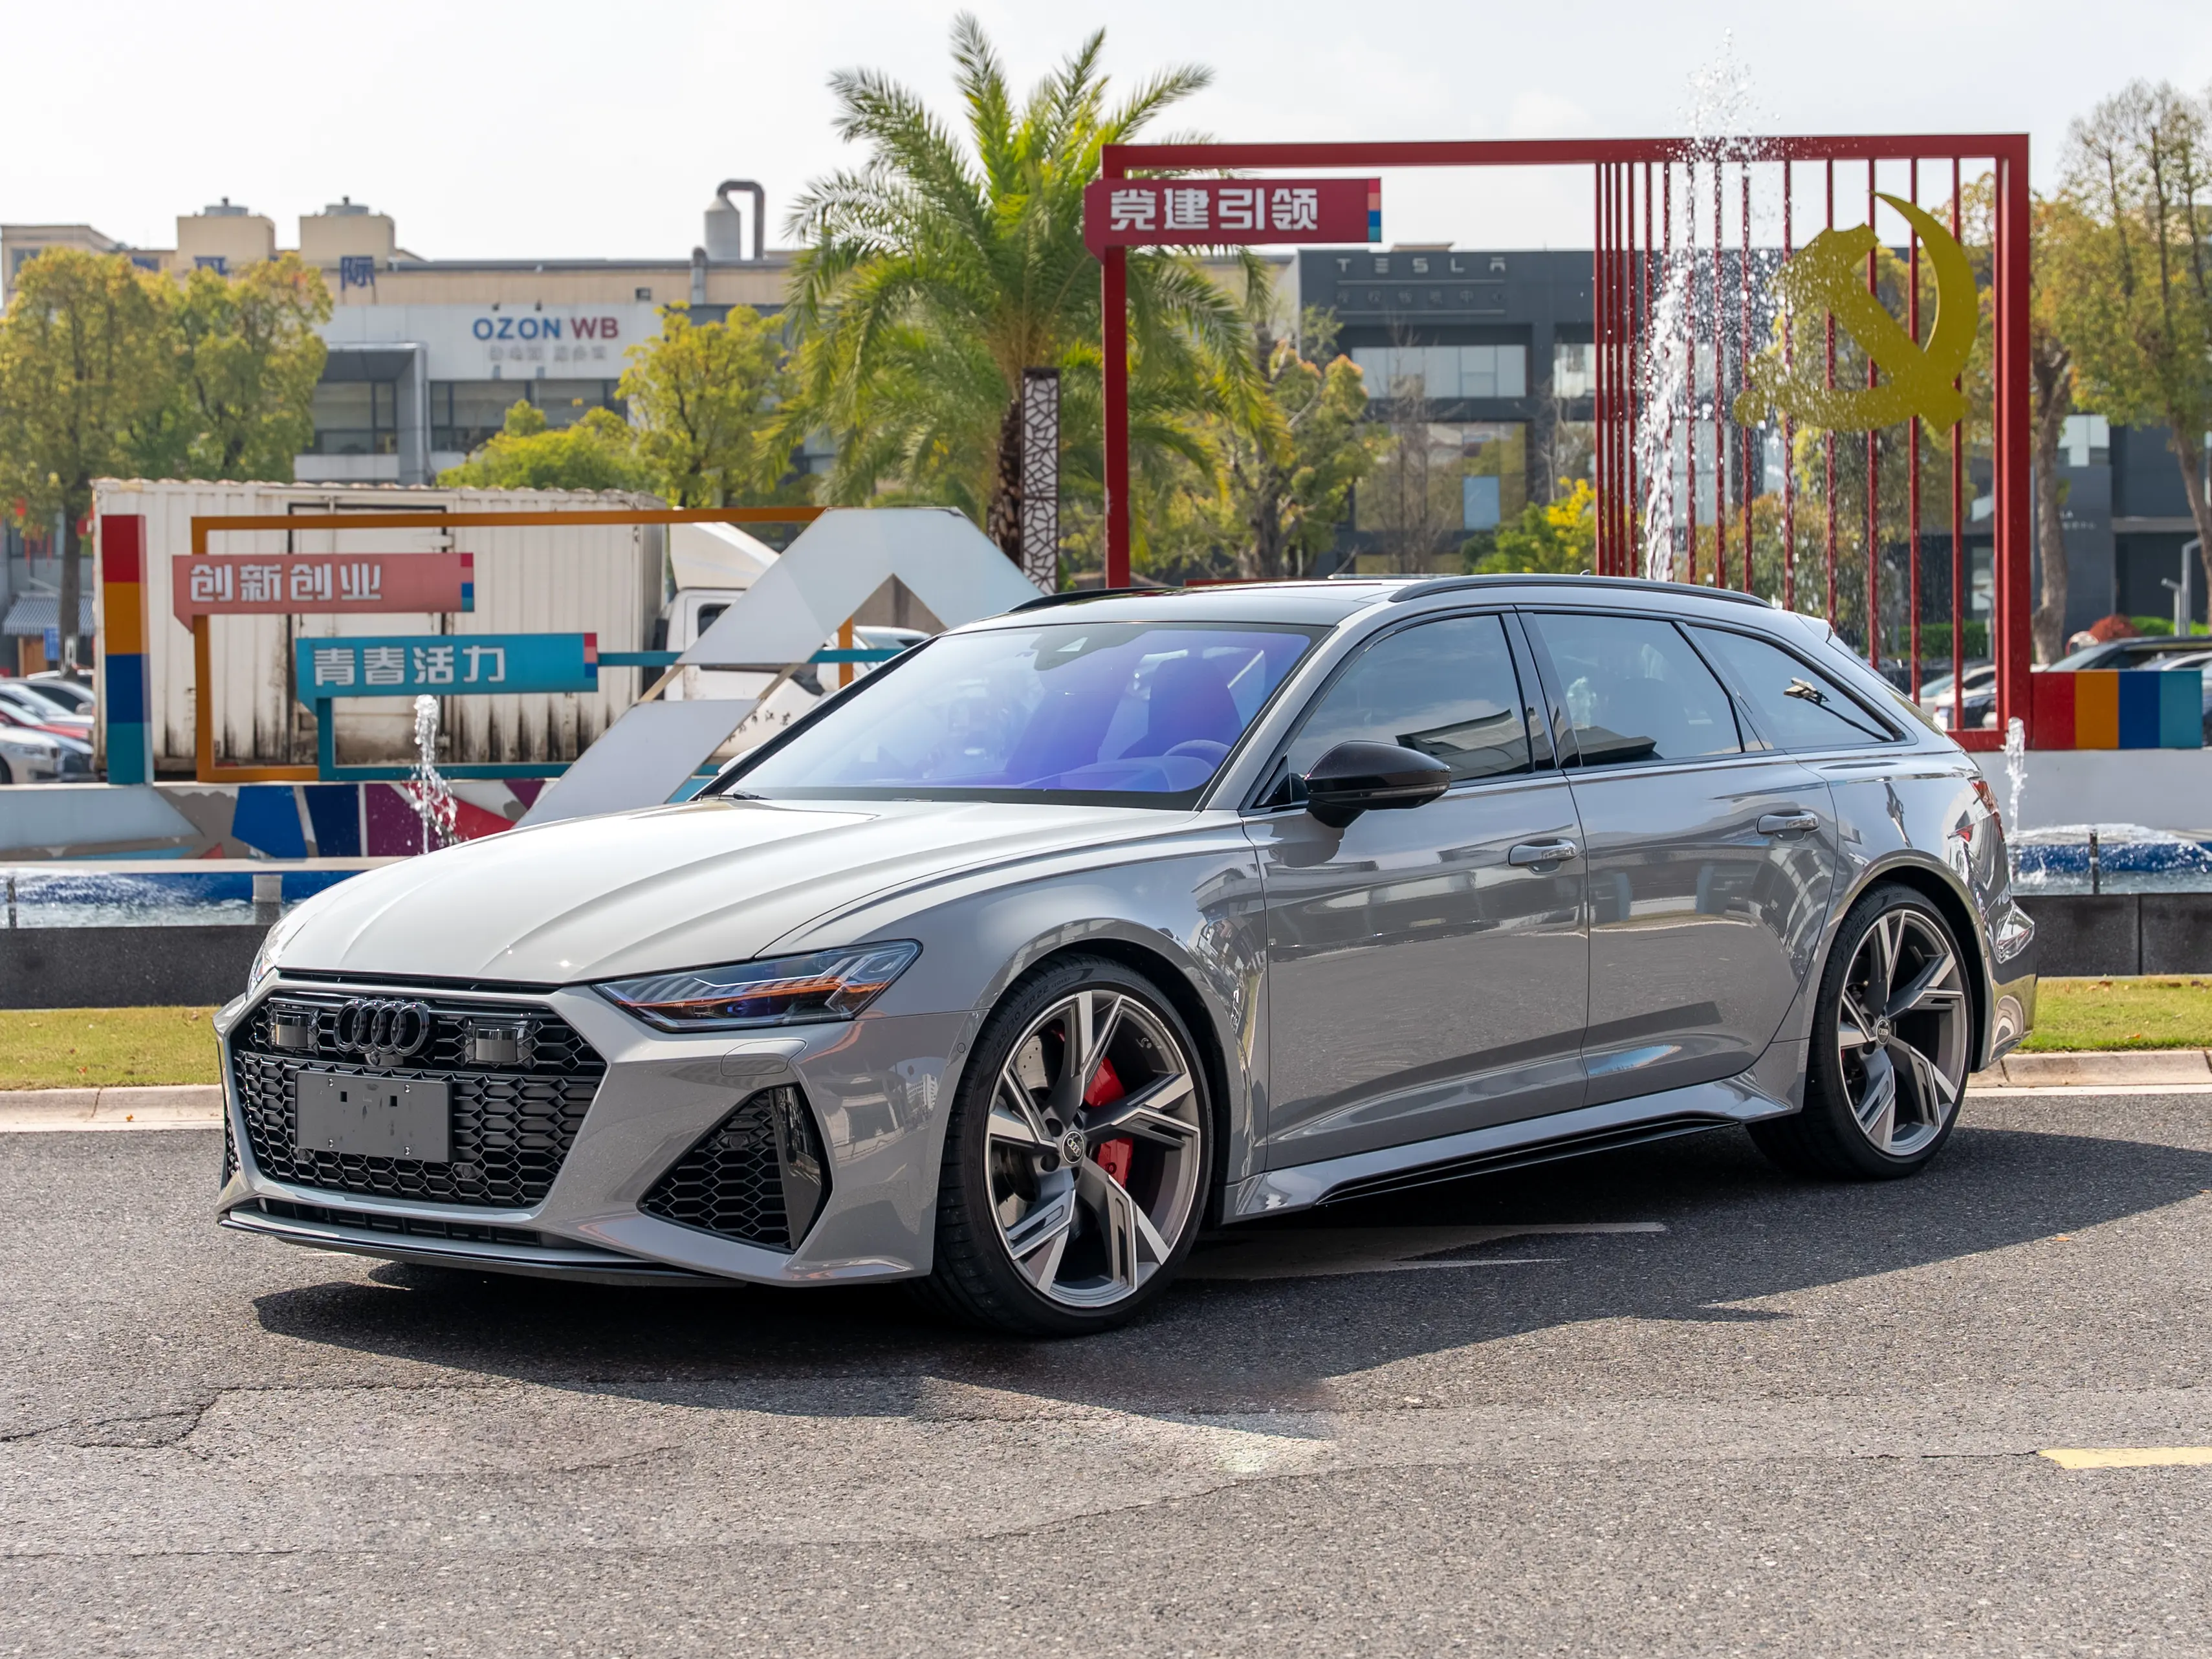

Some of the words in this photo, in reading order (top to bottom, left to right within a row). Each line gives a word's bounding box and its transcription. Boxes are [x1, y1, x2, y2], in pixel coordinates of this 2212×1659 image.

[463, 188, 671, 230] 党建引领
[1337, 257, 1506, 273] TESLA
[473, 317, 562, 340] OZON
[571, 317, 619, 339] WB
[190, 563, 382, 602] 创新创业
[314, 645, 506, 686] 青春活力
[1022, 985, 1049, 1011] ZR22
